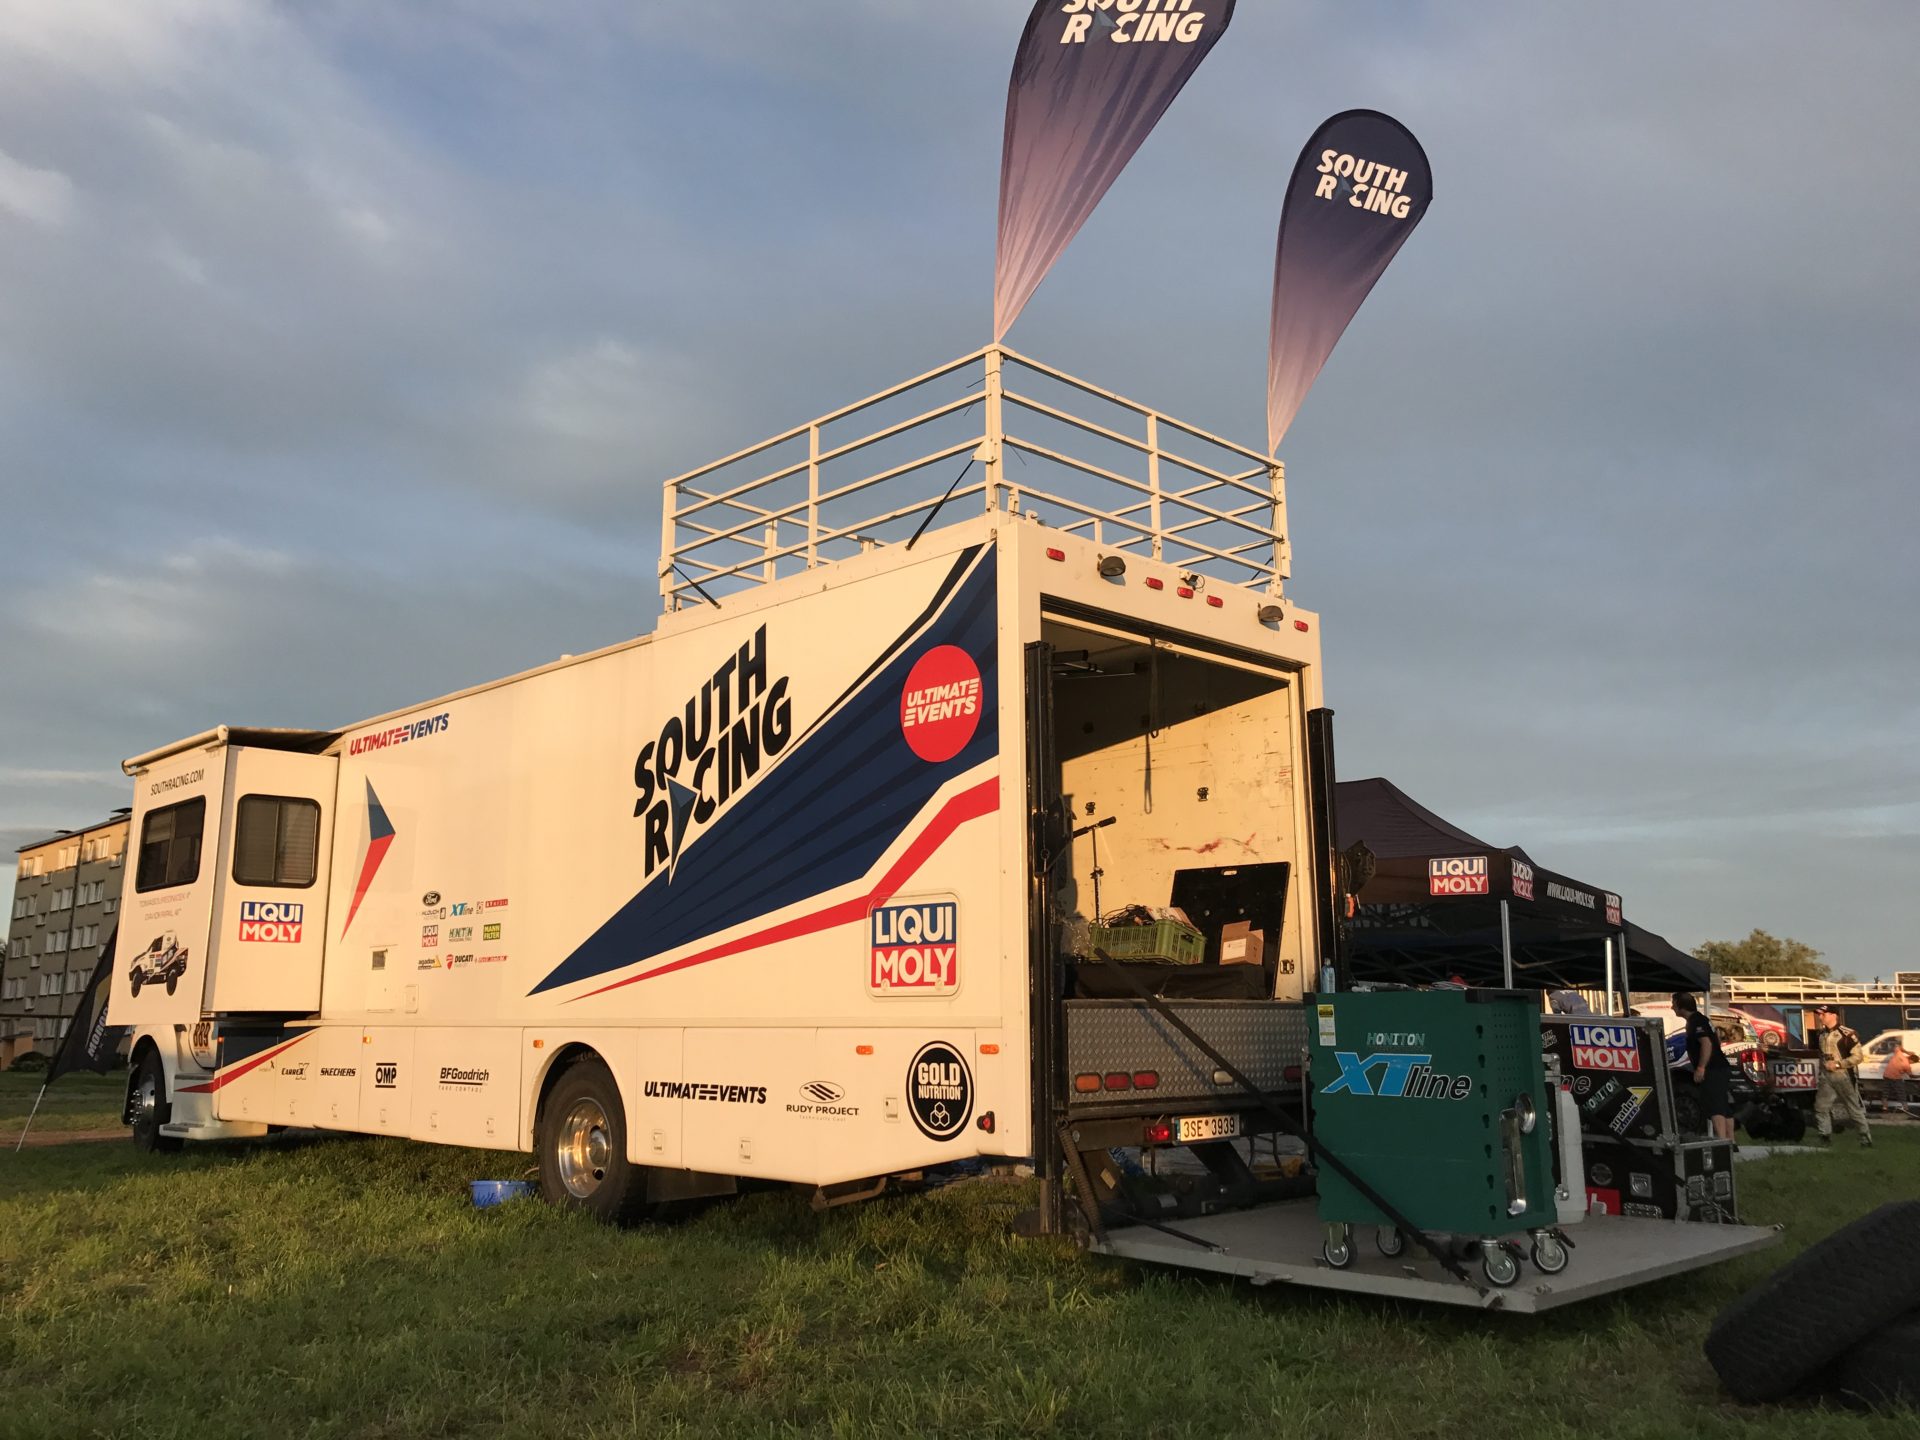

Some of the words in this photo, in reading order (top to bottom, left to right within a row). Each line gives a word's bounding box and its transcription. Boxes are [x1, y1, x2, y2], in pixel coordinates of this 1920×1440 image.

[1316, 149, 1408, 193] SOUTH
[907, 678, 979, 706] ULTIMATE
[633, 622, 767, 817] SOUTH
[904, 696, 976, 727] EVENTS
[150, 769, 205, 796] SOUTHRACING.COM
[1432, 858, 1484, 876] LIQUI
[1512, 861, 1533, 881] LIQUI
[1433, 876, 1487, 893] MOLY
[243, 902, 302, 922] LIQUI
[241, 923, 300, 942] MOLY
[423, 925, 438, 936] LIQUI
[875, 905, 954, 945] LIQUI
[422, 936, 437, 946] MOLY
[454, 954, 474, 963] DUCATI
[876, 947, 955, 983] MOLY
[1366, 1032, 1425, 1046] HONITON
[1573, 1027, 1633, 1048] LIQUI
[1576, 1050, 1636, 1069] MOLY
[320, 1067, 356, 1077] SKECHERS
[375, 1067, 397, 1084] OMP
[440, 1067, 490, 1081] BFGoodrich
[918, 1062, 961, 1086] GOLD
[1320, 1051, 1473, 1101] XTline
[1775, 1063, 1813, 1076] LIQUI
[1775, 1075, 1814, 1088] MOLY
[786, 1104, 813, 1113] RUDY
[815, 1106, 860, 1116] PROJECT
[1183, 1119, 1204, 1138] 3SE
[1211, 1116, 1236, 1136] 3939
